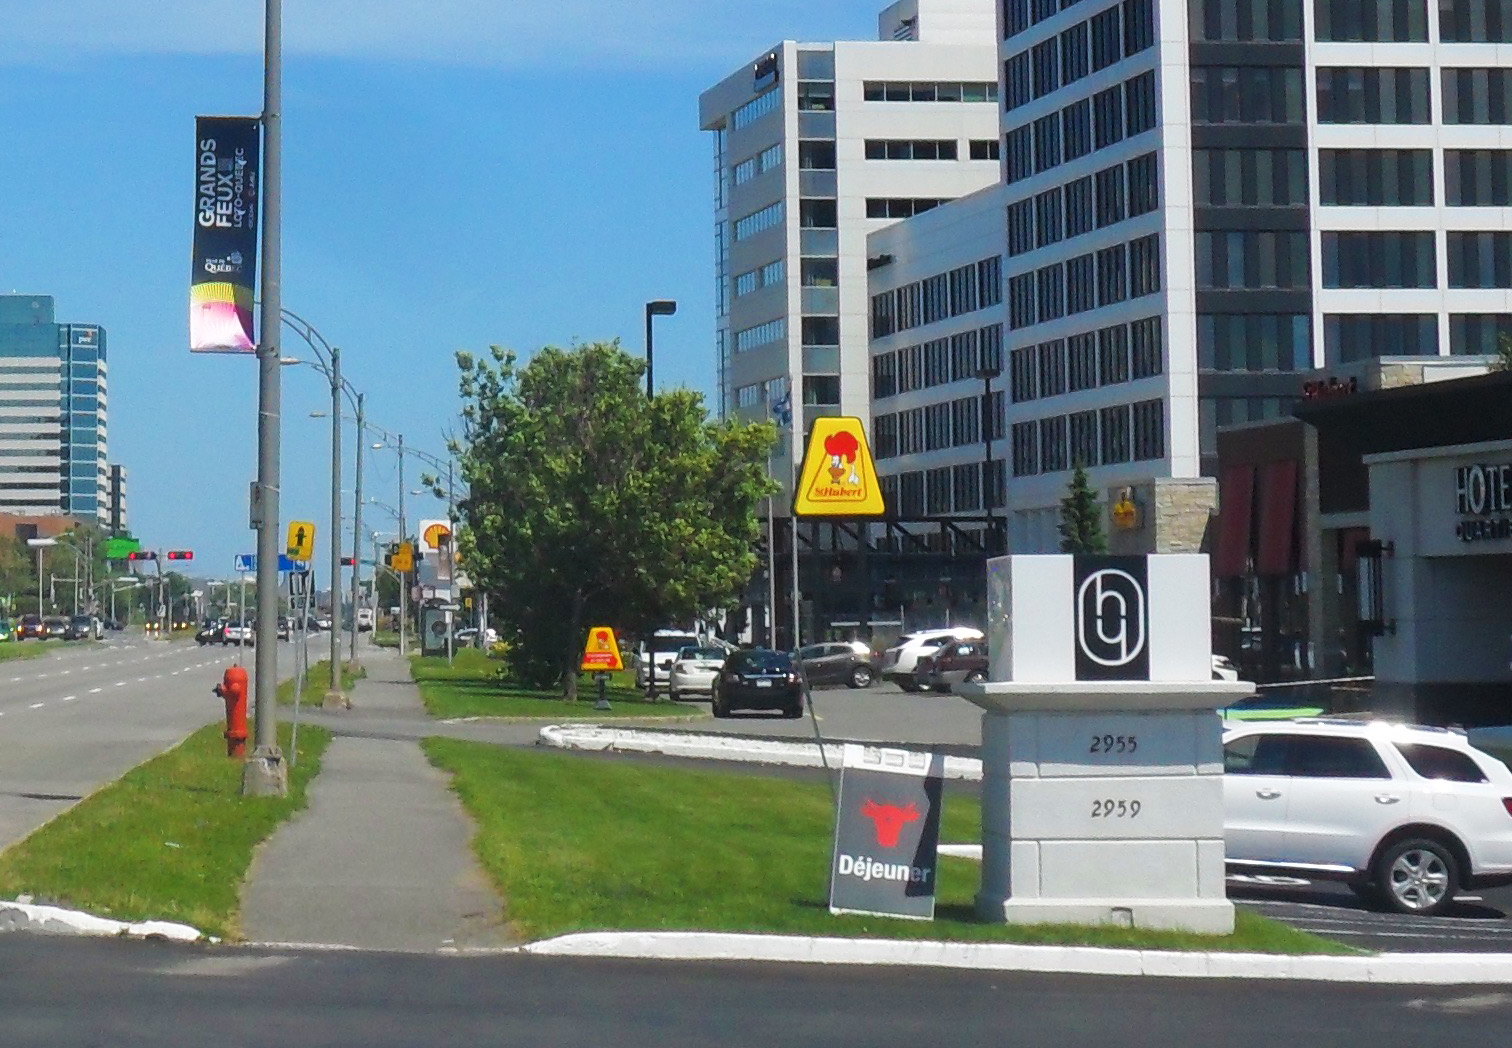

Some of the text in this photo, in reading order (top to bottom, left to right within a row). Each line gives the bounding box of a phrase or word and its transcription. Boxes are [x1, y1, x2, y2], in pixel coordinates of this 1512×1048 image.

[199, 138, 217, 227] GRANDS
[216, 170, 233, 227] FEUX
[1090, 735, 1137, 753] 2955
[1091, 799, 1141, 818] 2959
[839, 854, 931, 883] Déjeuner
